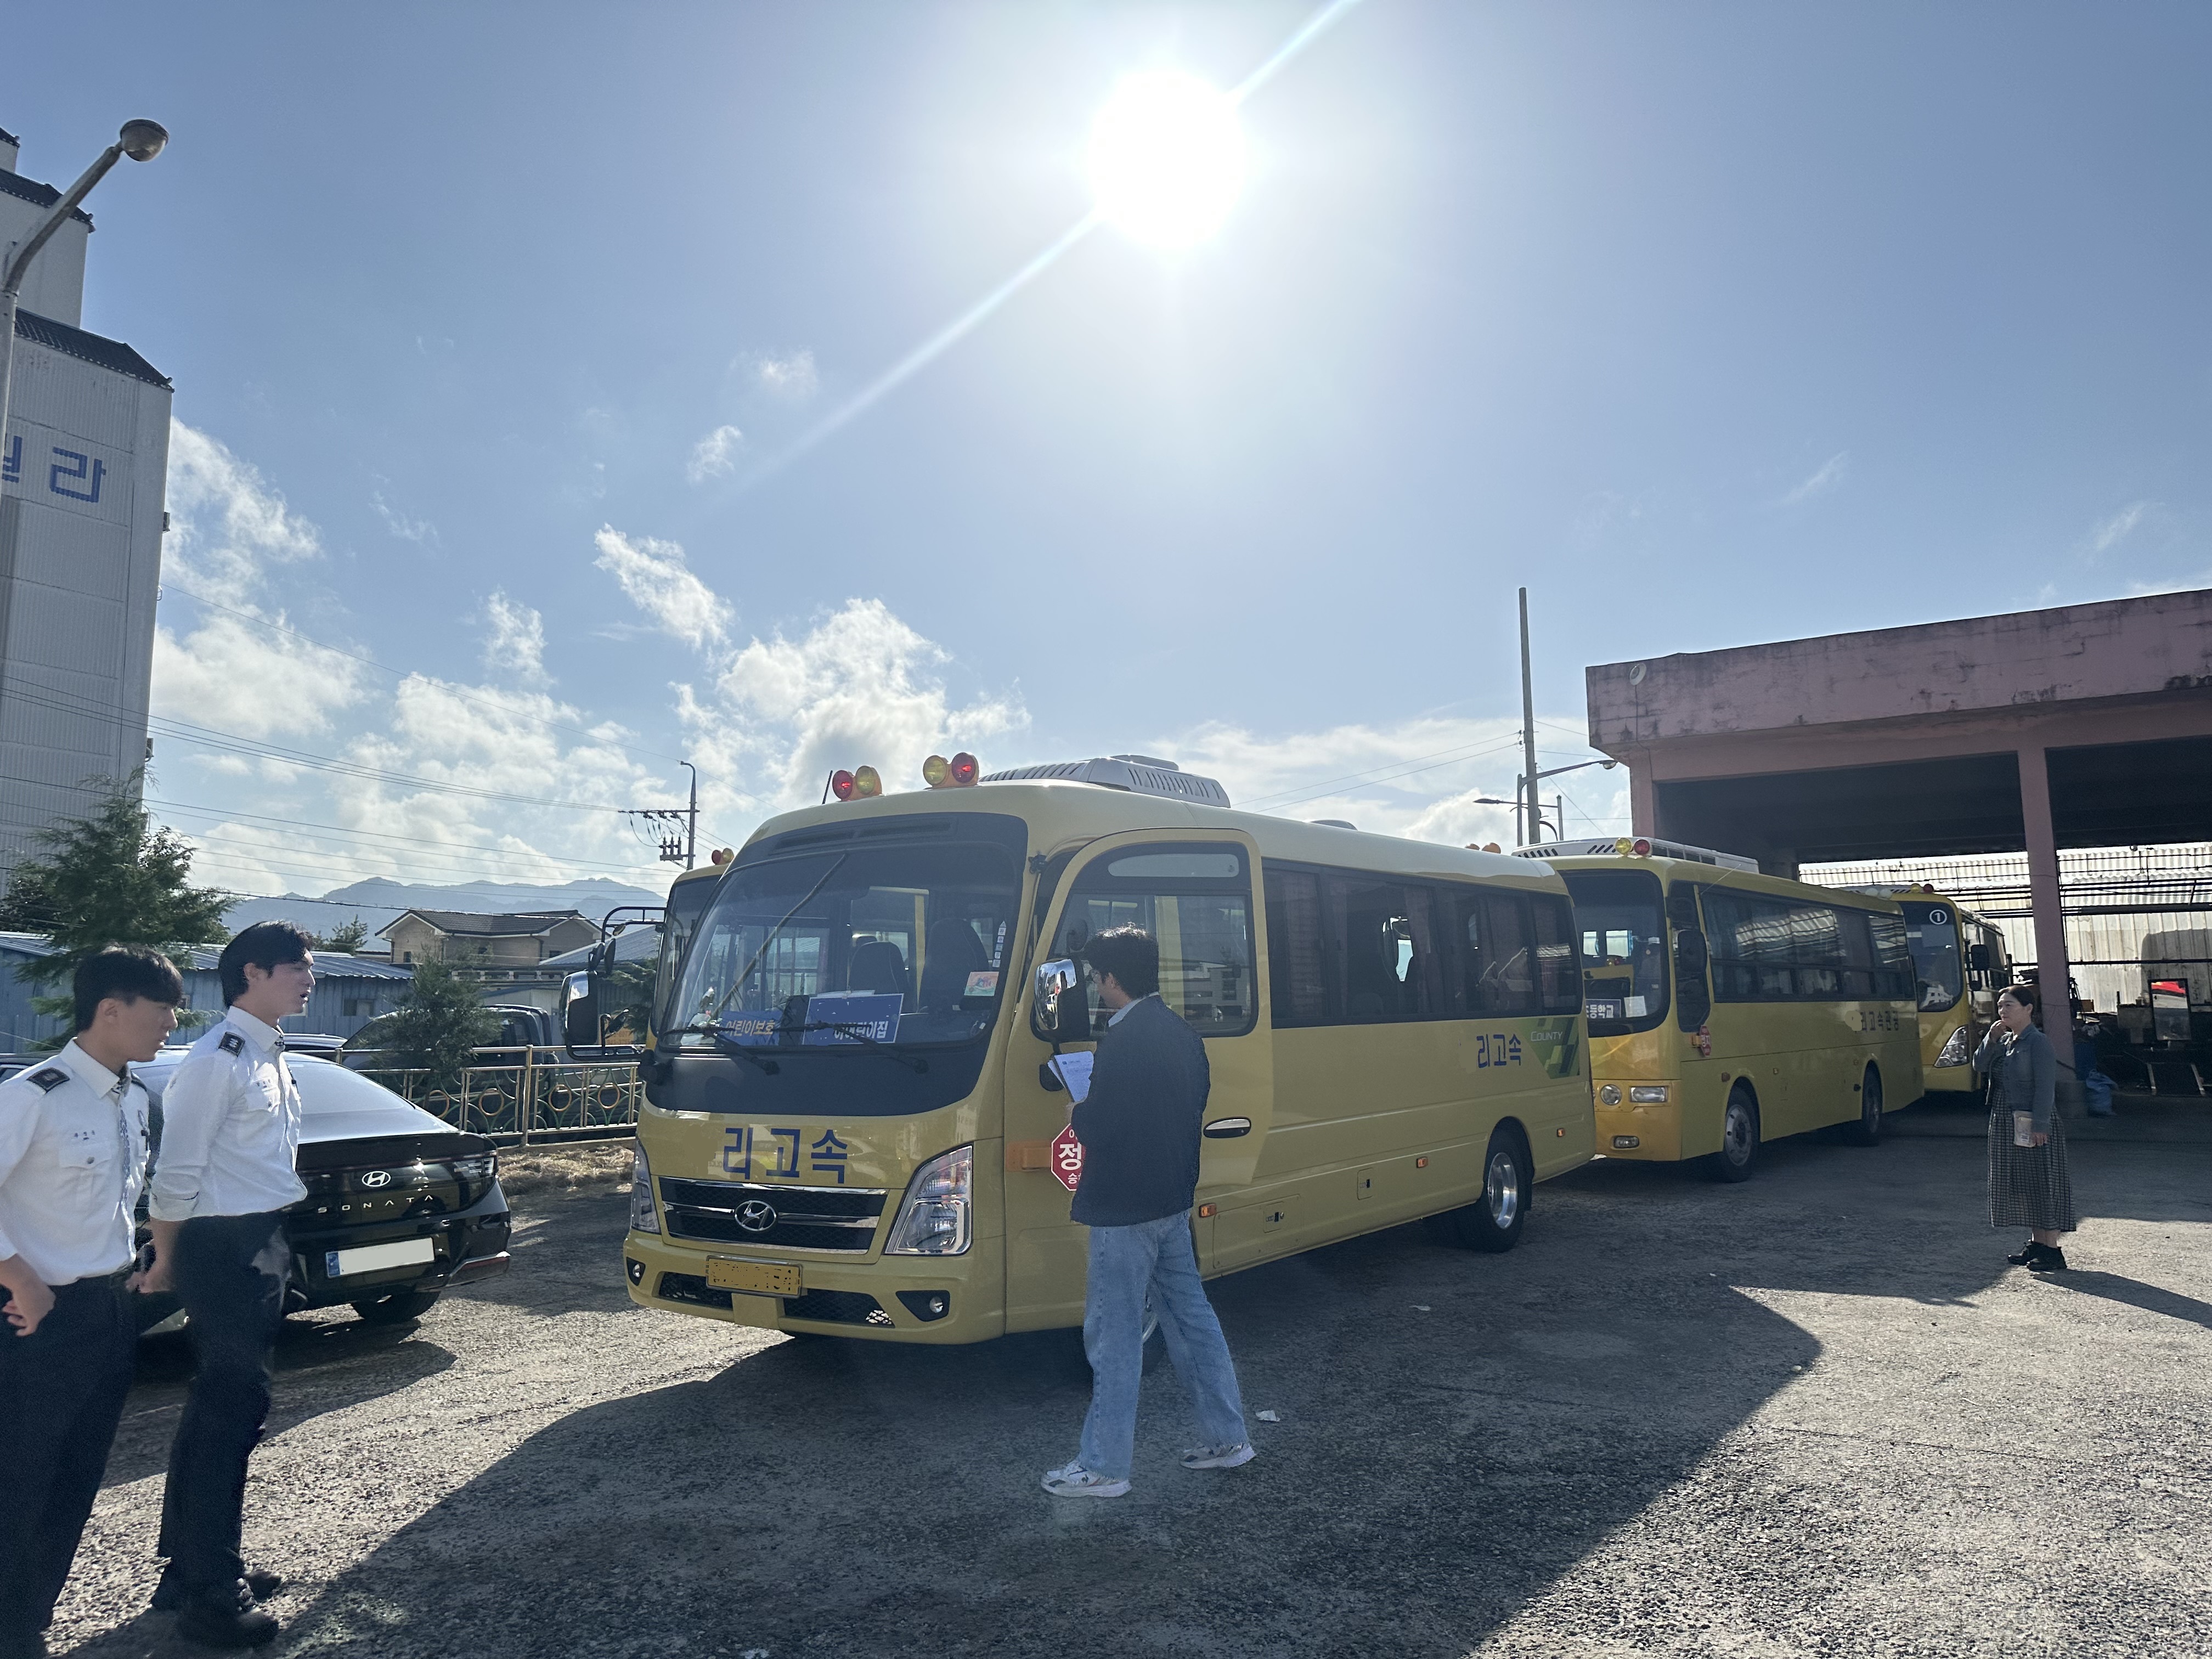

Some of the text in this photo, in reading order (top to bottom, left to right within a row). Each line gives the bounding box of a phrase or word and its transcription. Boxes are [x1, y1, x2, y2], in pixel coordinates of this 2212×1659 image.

[1531, 1031, 1563, 1041] COUNTY
[1058, 1142, 1082, 1171] 정
[318, 1195, 433, 1213] SONATA
